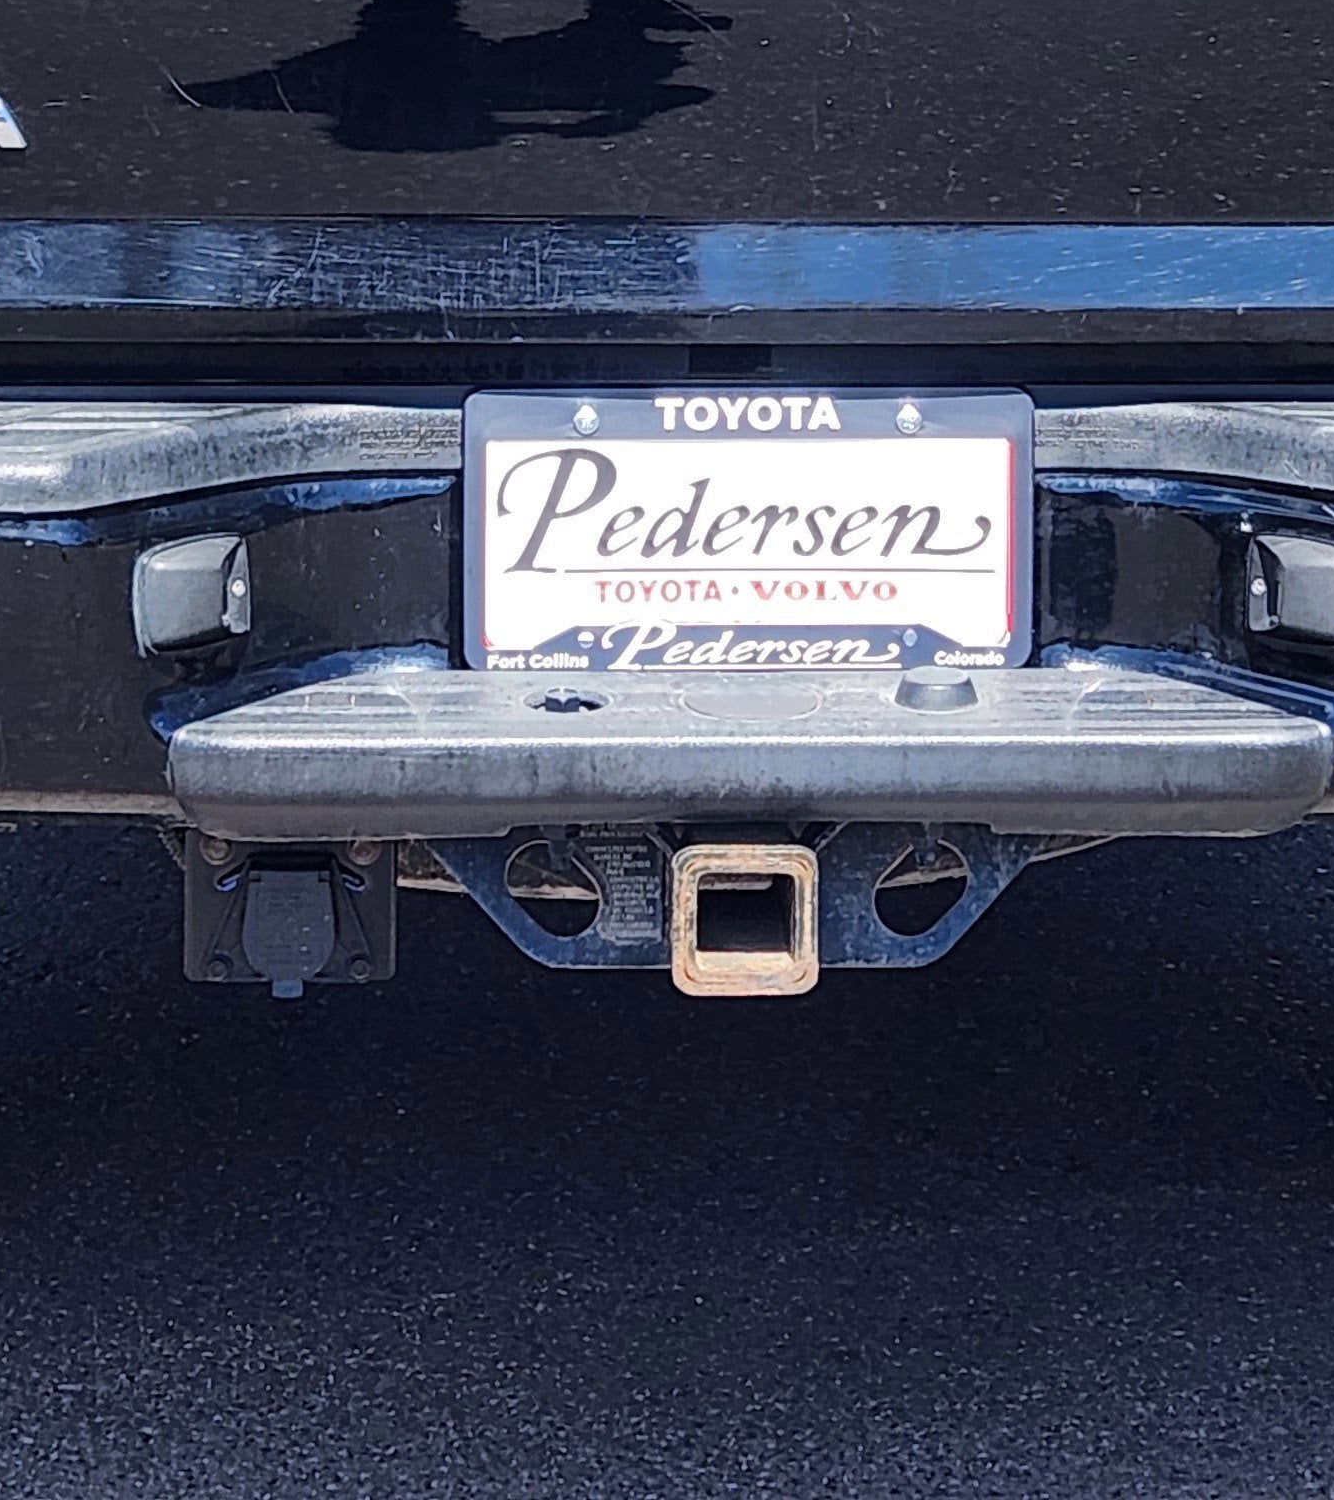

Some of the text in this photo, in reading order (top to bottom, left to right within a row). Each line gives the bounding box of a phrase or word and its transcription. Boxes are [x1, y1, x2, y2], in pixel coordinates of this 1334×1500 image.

[654, 397, 841, 431] TOYOTA
[497, 447, 992, 574] Pedersen
[595, 580, 897, 603] TOYOTA VOLVO
[601, 619, 901, 670] Pedersen
[934, 650, 1005, 666] Colorado
[487, 652, 589, 670] Fort Collins
